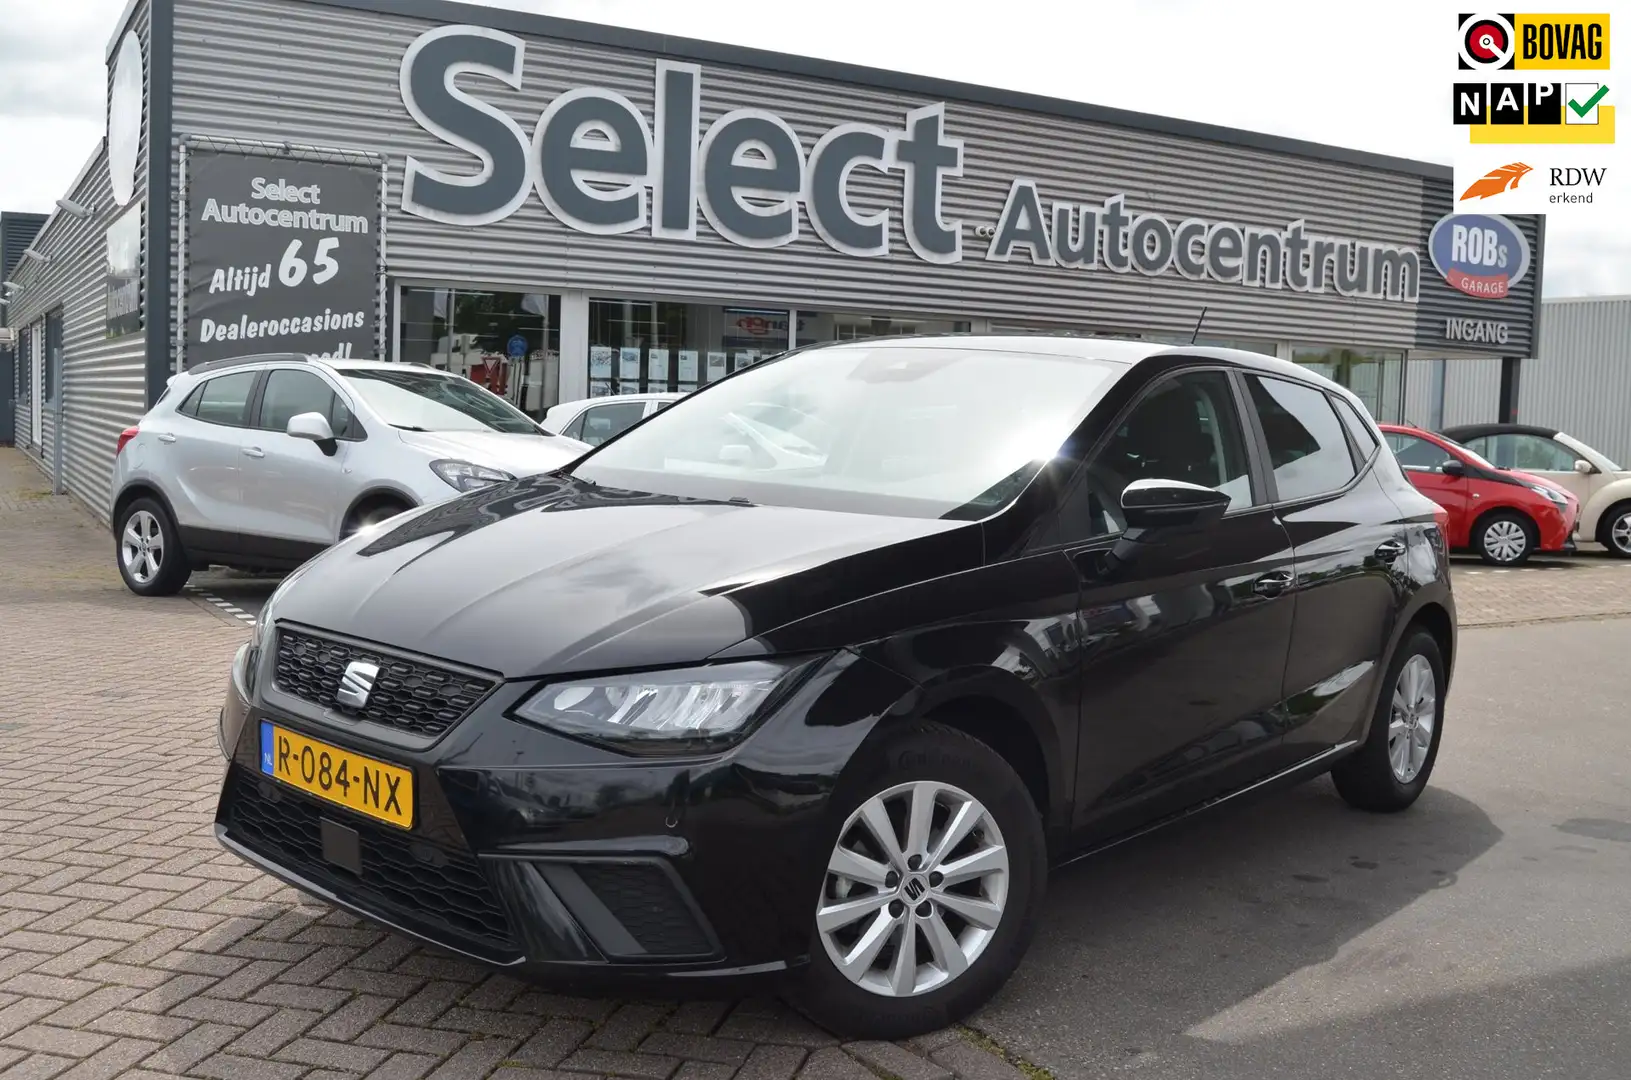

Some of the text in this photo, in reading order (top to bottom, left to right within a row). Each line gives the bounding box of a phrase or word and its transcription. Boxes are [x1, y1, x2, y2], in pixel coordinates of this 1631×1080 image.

[399, 24, 965, 265] Select
[251, 177, 321, 204] Select
[201, 198, 369, 234] Autocentrum
[985, 178, 1421, 303] Autocentrum
[209, 237, 340, 297] Altijd 65
[1461, 277, 1504, 294] GARAGE
[200, 308, 365, 343] Dealeroccasions
[1445, 317, 1508, 344] INGANG
[264, 735, 402, 816] NL R-084-NX
